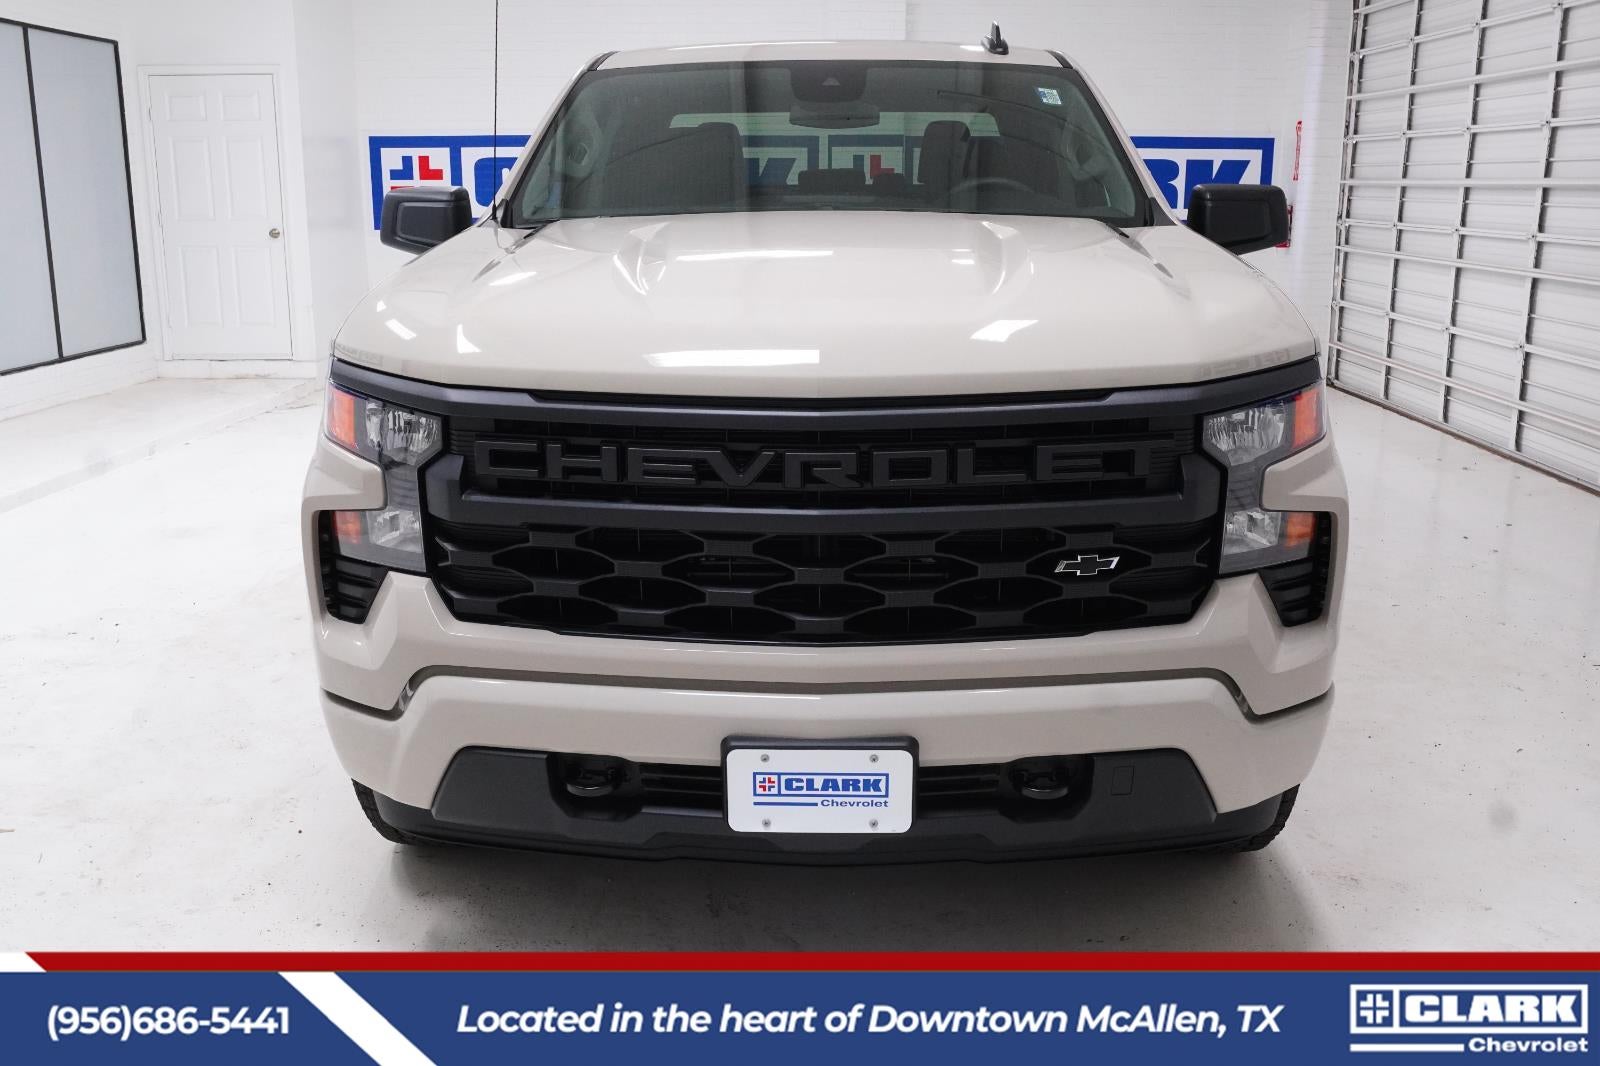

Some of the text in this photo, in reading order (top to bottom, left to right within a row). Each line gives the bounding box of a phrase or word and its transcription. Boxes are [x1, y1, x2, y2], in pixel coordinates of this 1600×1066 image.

[474, 438, 1175, 489] CHEVROLET
[784, 777, 883, 792] CLARK
[820, 799, 889, 808] Chevrolet
